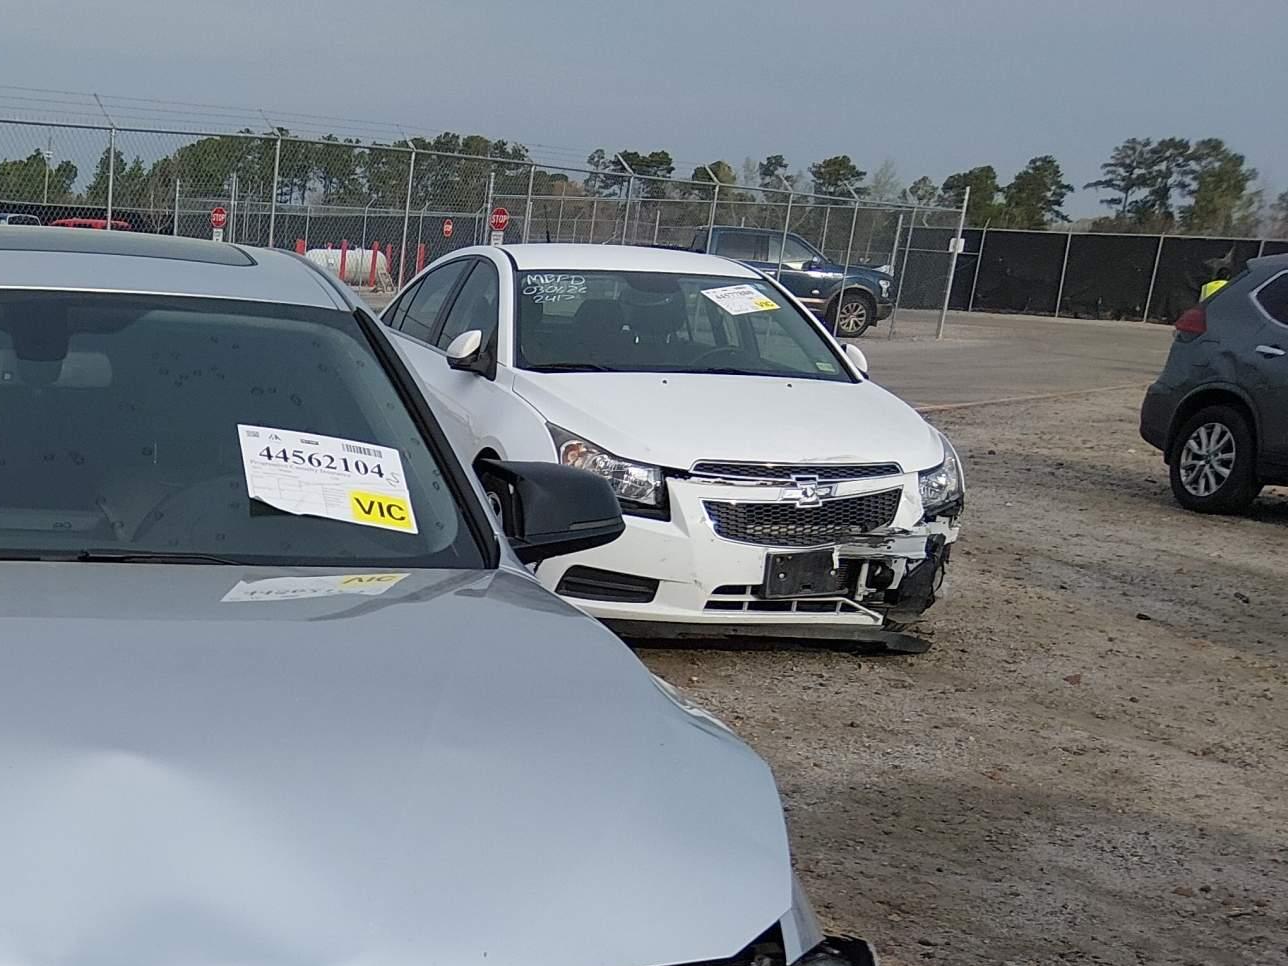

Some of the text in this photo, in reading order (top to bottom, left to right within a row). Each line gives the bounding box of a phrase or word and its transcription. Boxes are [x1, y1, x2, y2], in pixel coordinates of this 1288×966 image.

[492, 214, 508, 224] STOP
[259, 446, 385, 479] 44562104
[354, 497, 406, 521] VIC
